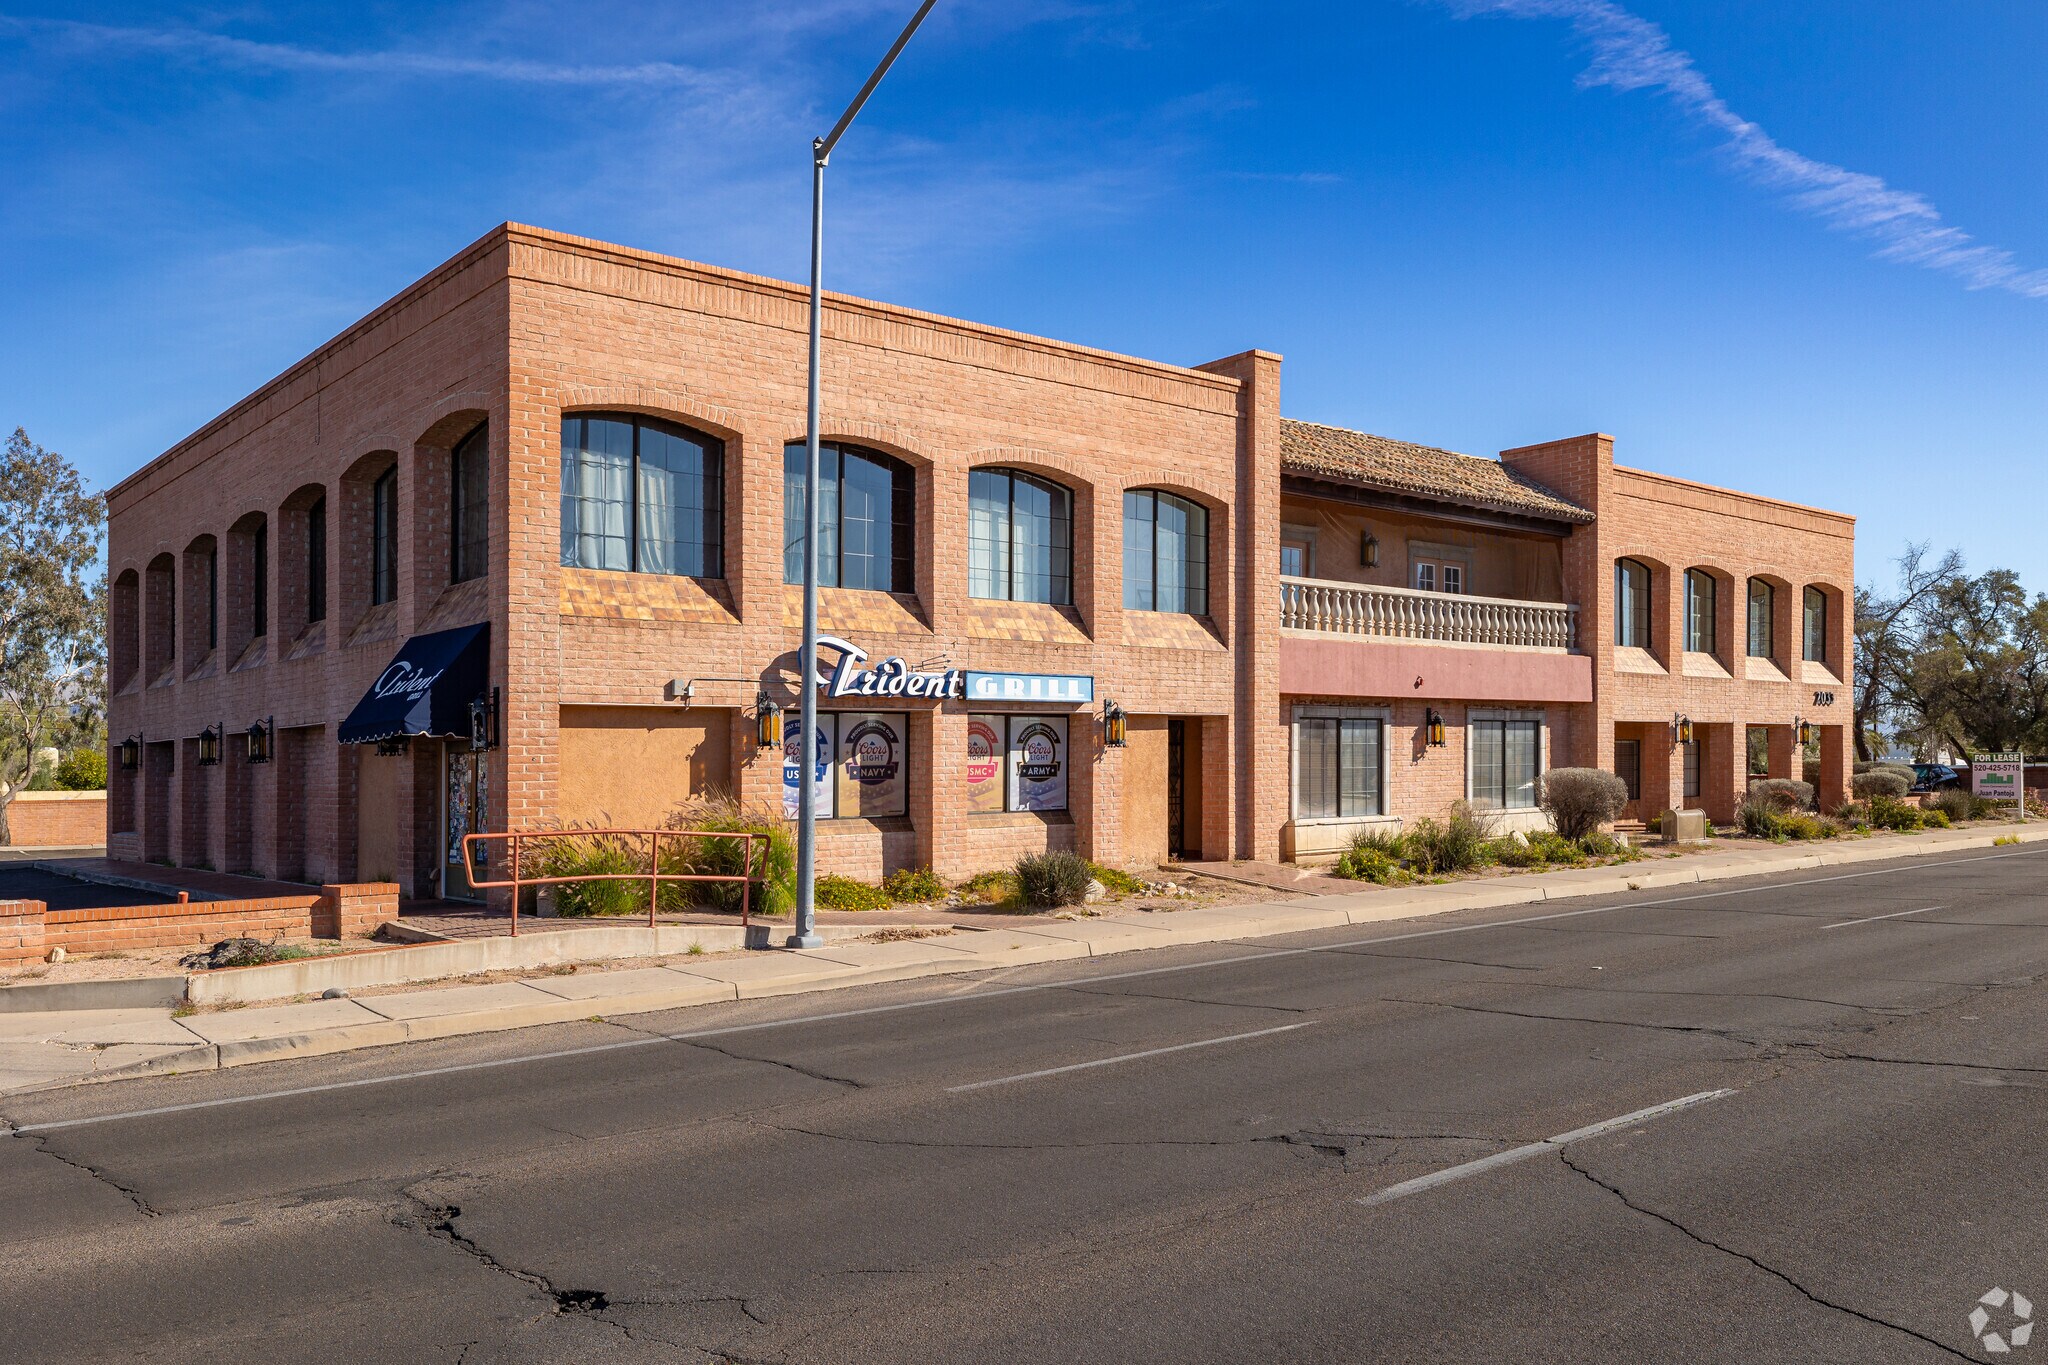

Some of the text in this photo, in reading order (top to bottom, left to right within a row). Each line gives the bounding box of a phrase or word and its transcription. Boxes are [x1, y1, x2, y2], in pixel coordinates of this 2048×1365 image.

[798, 635, 1085, 698] Trident GRILL
[375, 661, 444, 700] Trident
[850, 722, 894, 740] PROUDLY SERVING OUR
[859, 742, 887, 754] Coors
[1028, 743, 1052, 754] Coors
[1974, 754, 2020, 762] FOR LEASE
[861, 768, 885, 777] NAVY
[969, 767, 988, 776] SMC
[1027, 767, 1050, 775] ARMY
